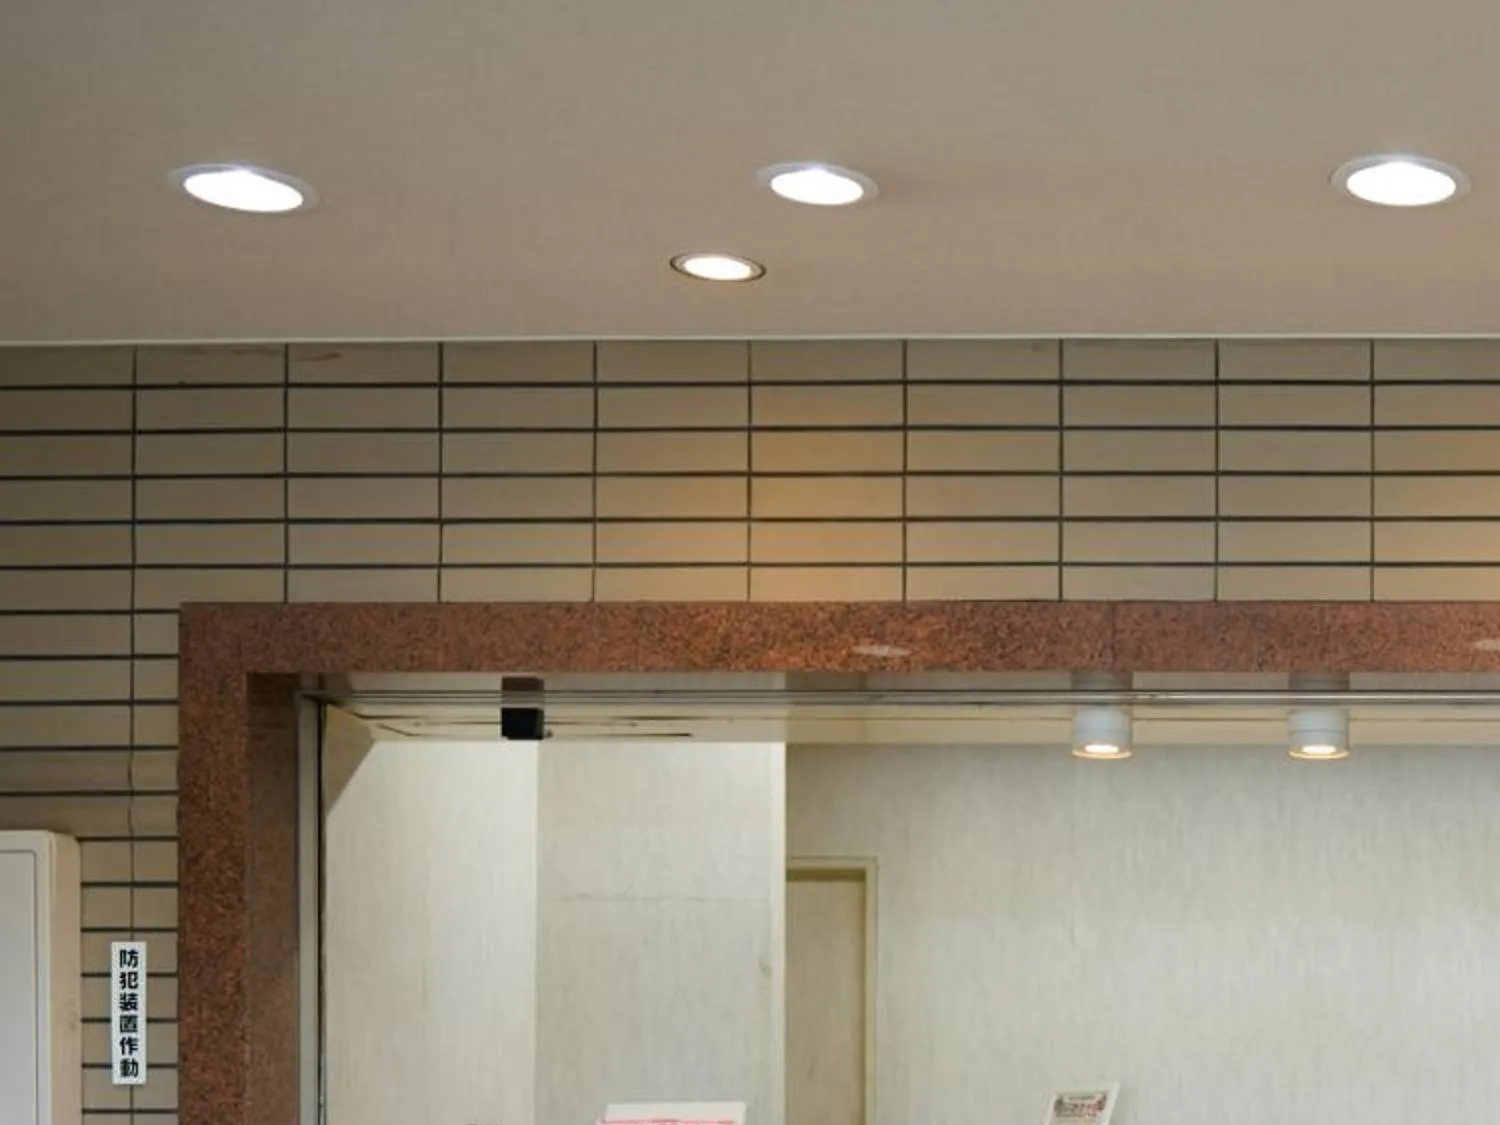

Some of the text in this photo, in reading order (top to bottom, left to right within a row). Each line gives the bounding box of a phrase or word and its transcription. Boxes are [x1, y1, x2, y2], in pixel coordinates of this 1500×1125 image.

[119, 949, 139, 1078] 防犯装置作動
